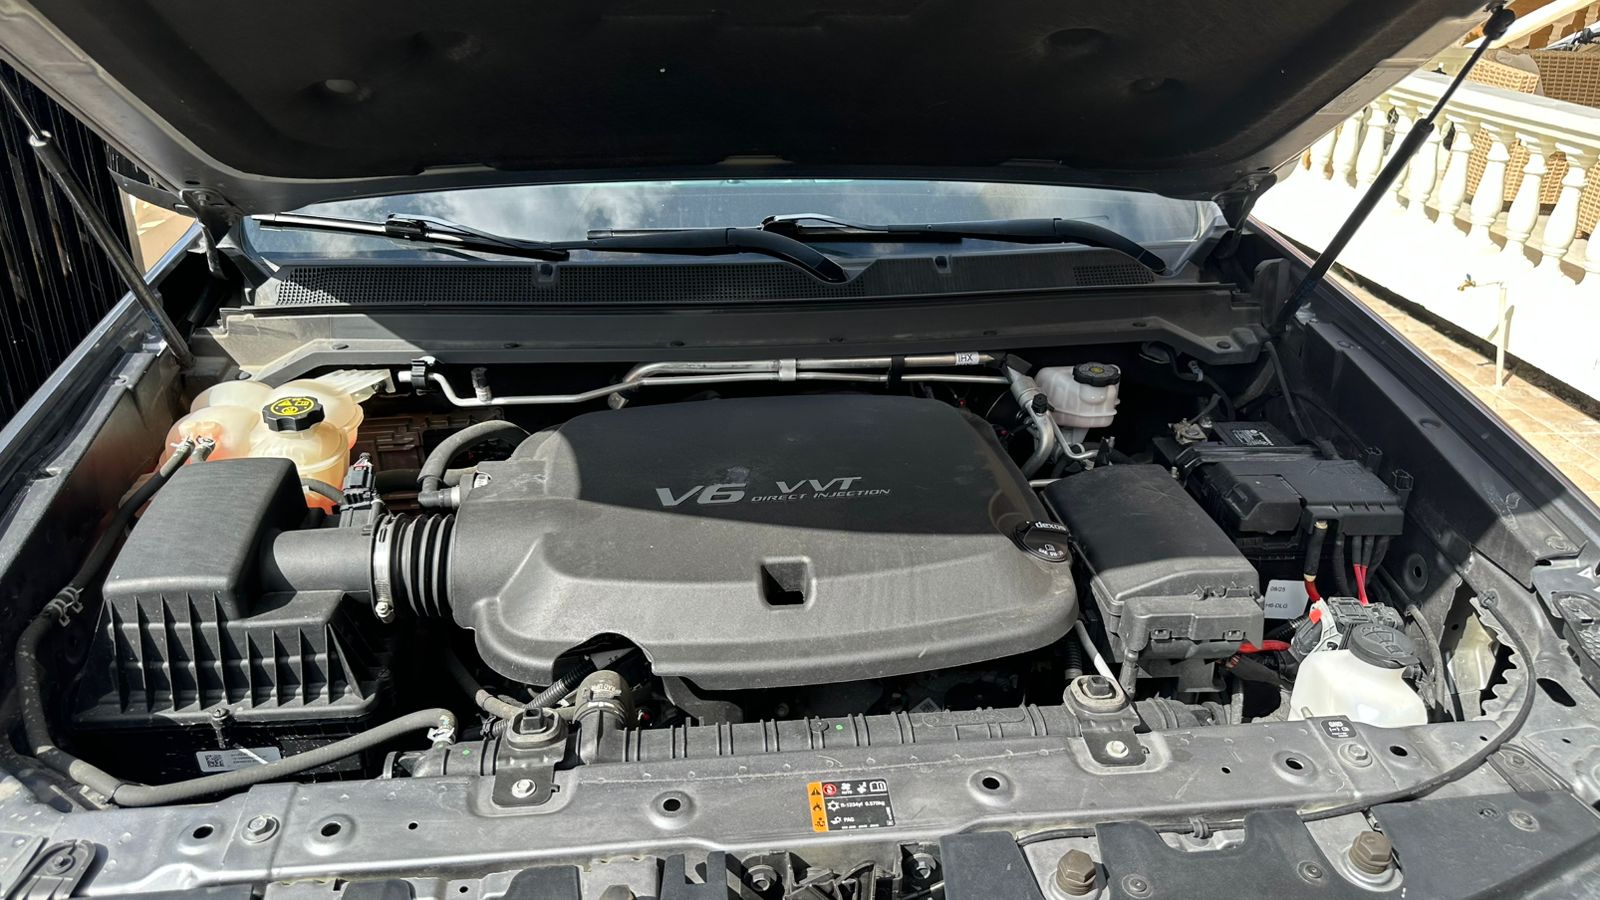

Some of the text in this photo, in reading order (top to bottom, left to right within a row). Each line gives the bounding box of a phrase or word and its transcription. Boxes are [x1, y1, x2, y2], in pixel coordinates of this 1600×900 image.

[776, 476, 862, 494] VVT
[656, 483, 747, 507] V6
[751, 489, 891, 503] DIRECT INJECTION
